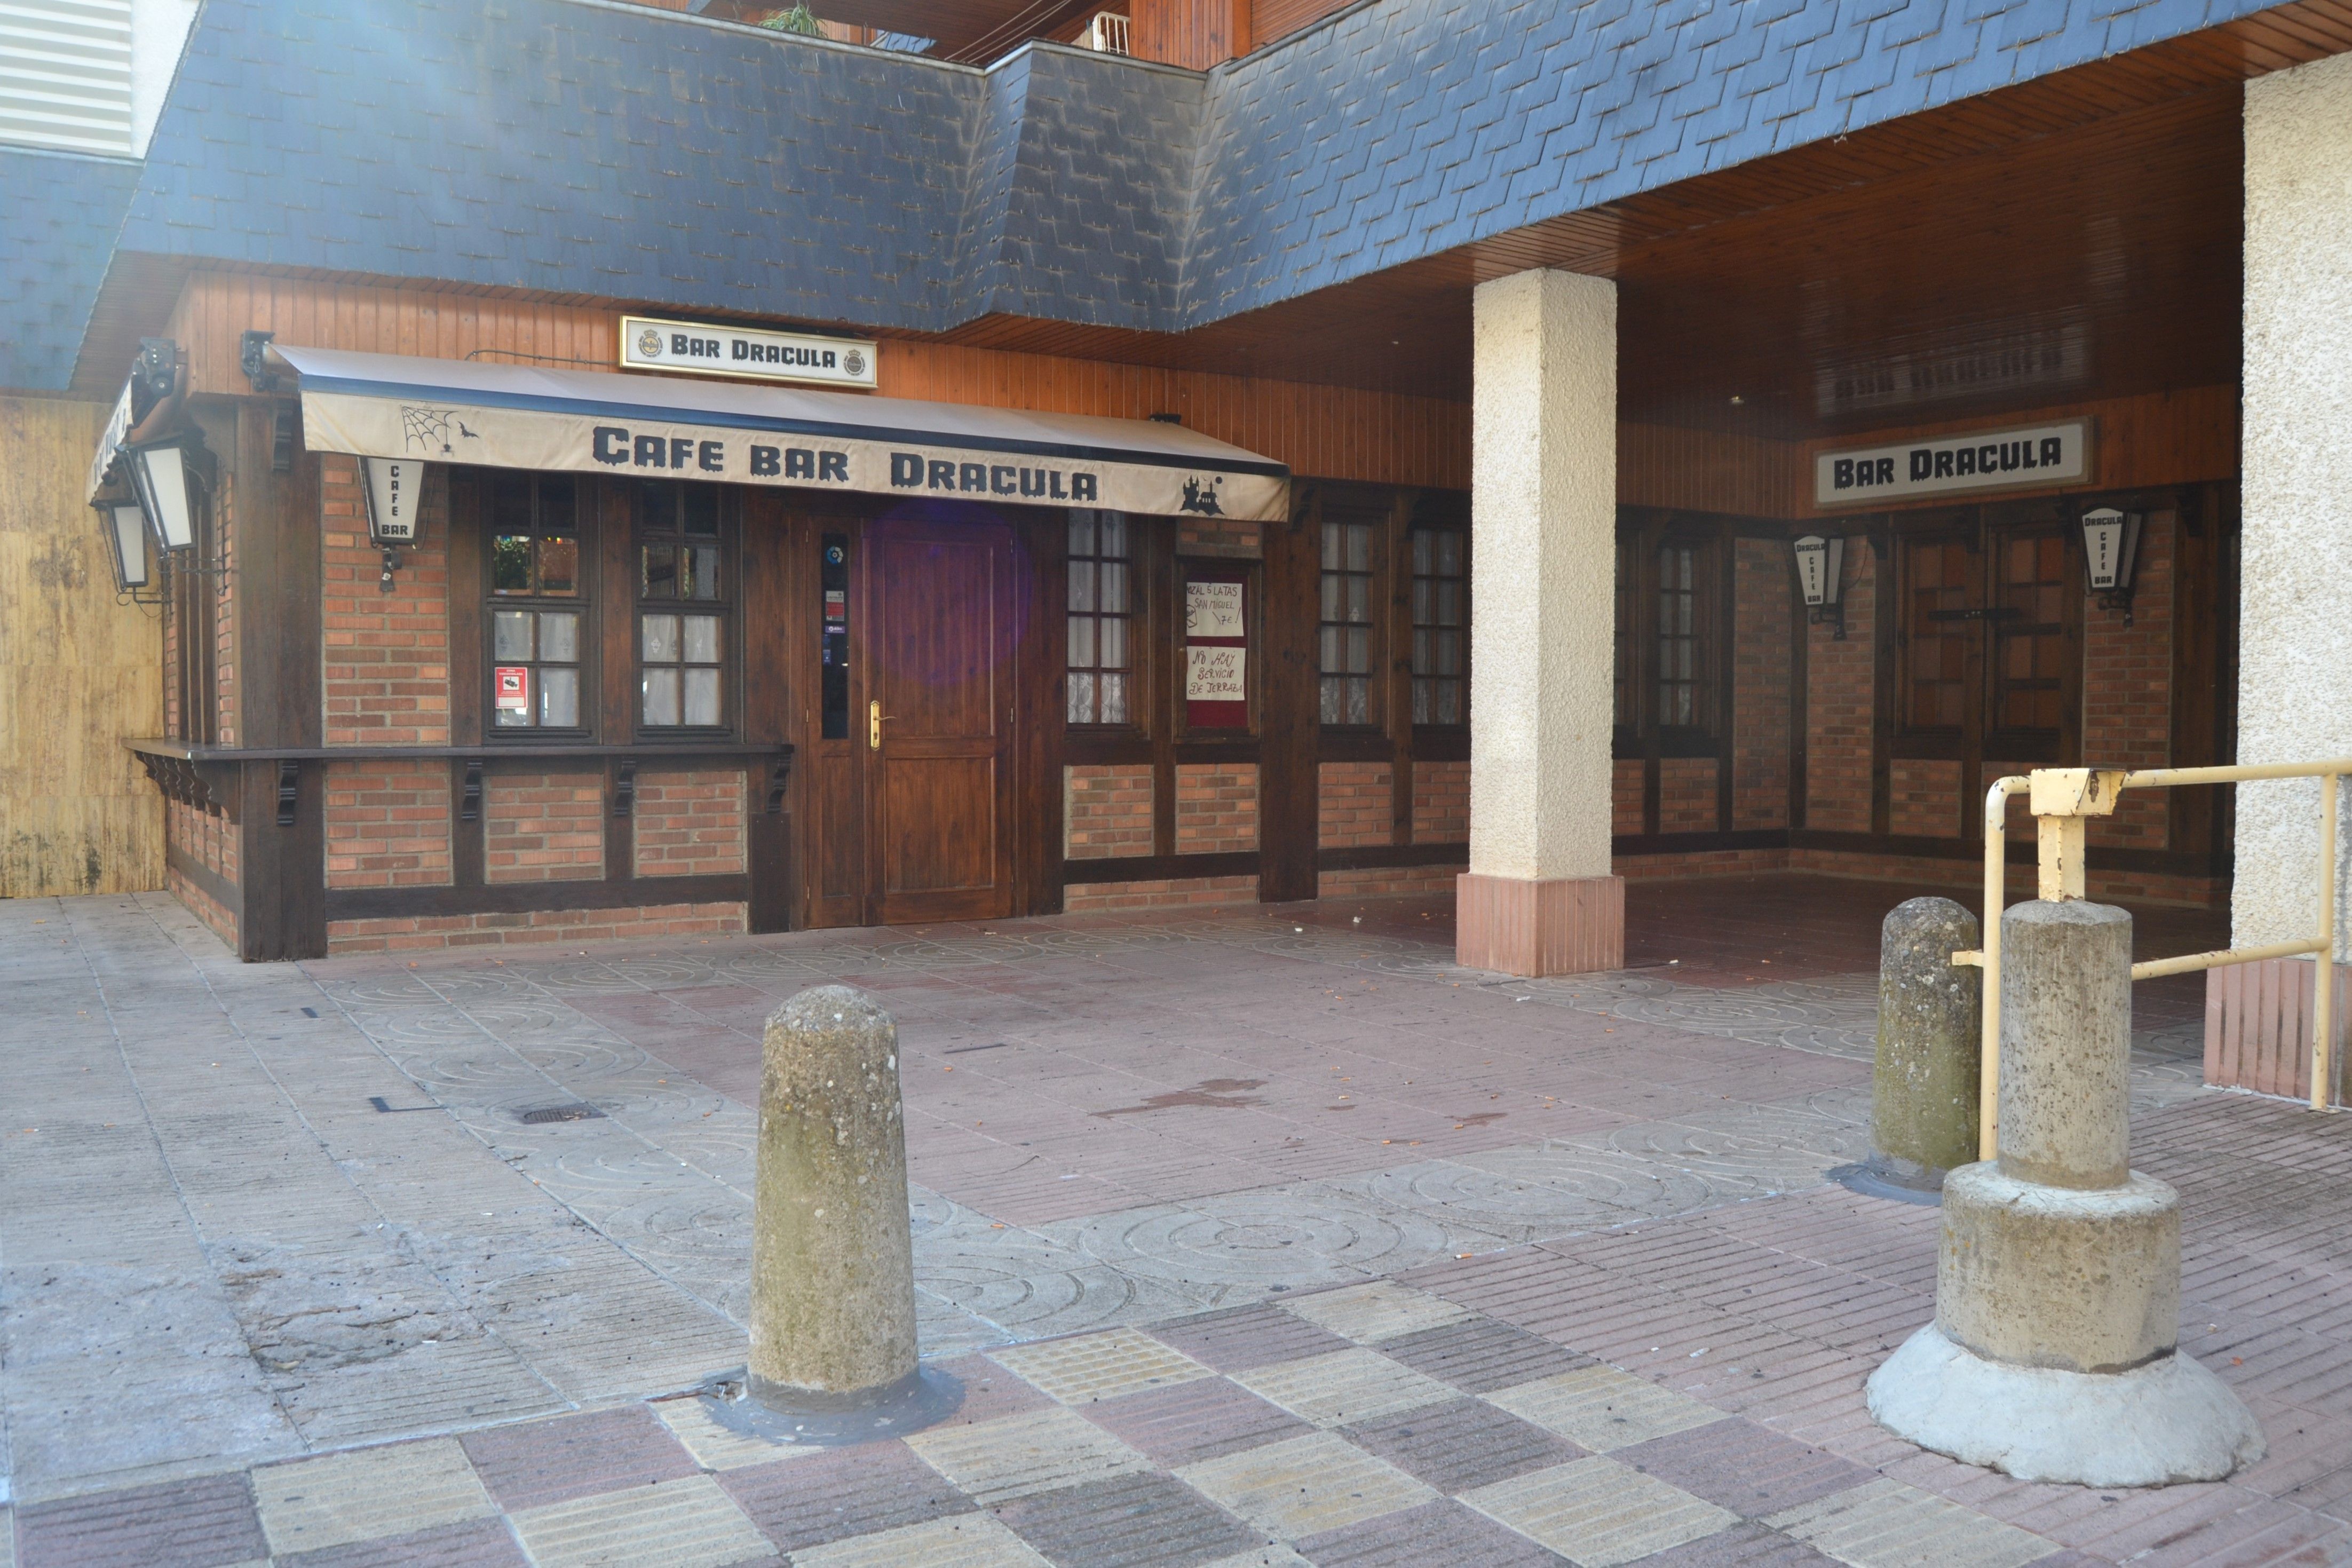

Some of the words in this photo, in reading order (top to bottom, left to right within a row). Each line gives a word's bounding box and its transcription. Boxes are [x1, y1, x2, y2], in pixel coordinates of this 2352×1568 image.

[671, 334, 720, 359] BAR
[732, 339, 836, 368] DRACULA
[593, 426, 723, 472] CAFE
[750, 445, 849, 482] BAR
[890, 452, 1097, 502] DRACULA
[1834, 457, 1894, 490] BAR
[1910, 437, 2061, 482] DRACULA
[391, 465, 399, 516] CAFE
[2085, 516, 2122, 526] DRACULA
[382, 525, 408, 535] BAR
[1796, 543, 1825, 552] DRACULA
[2095, 576, 2112, 584] BAR
[1207, 585, 1211, 593] 5
[1214, 586, 1237, 597] LATAS
[1195, 598, 1207, 609] SAN
[1193, 651, 1206, 664] NO
[1211, 651, 1235, 667] HAY
[1198, 667, 1234, 680] SERVICIO
[1189, 683, 1203, 694] DE
[1207, 683, 1242, 693] TERRAZA
